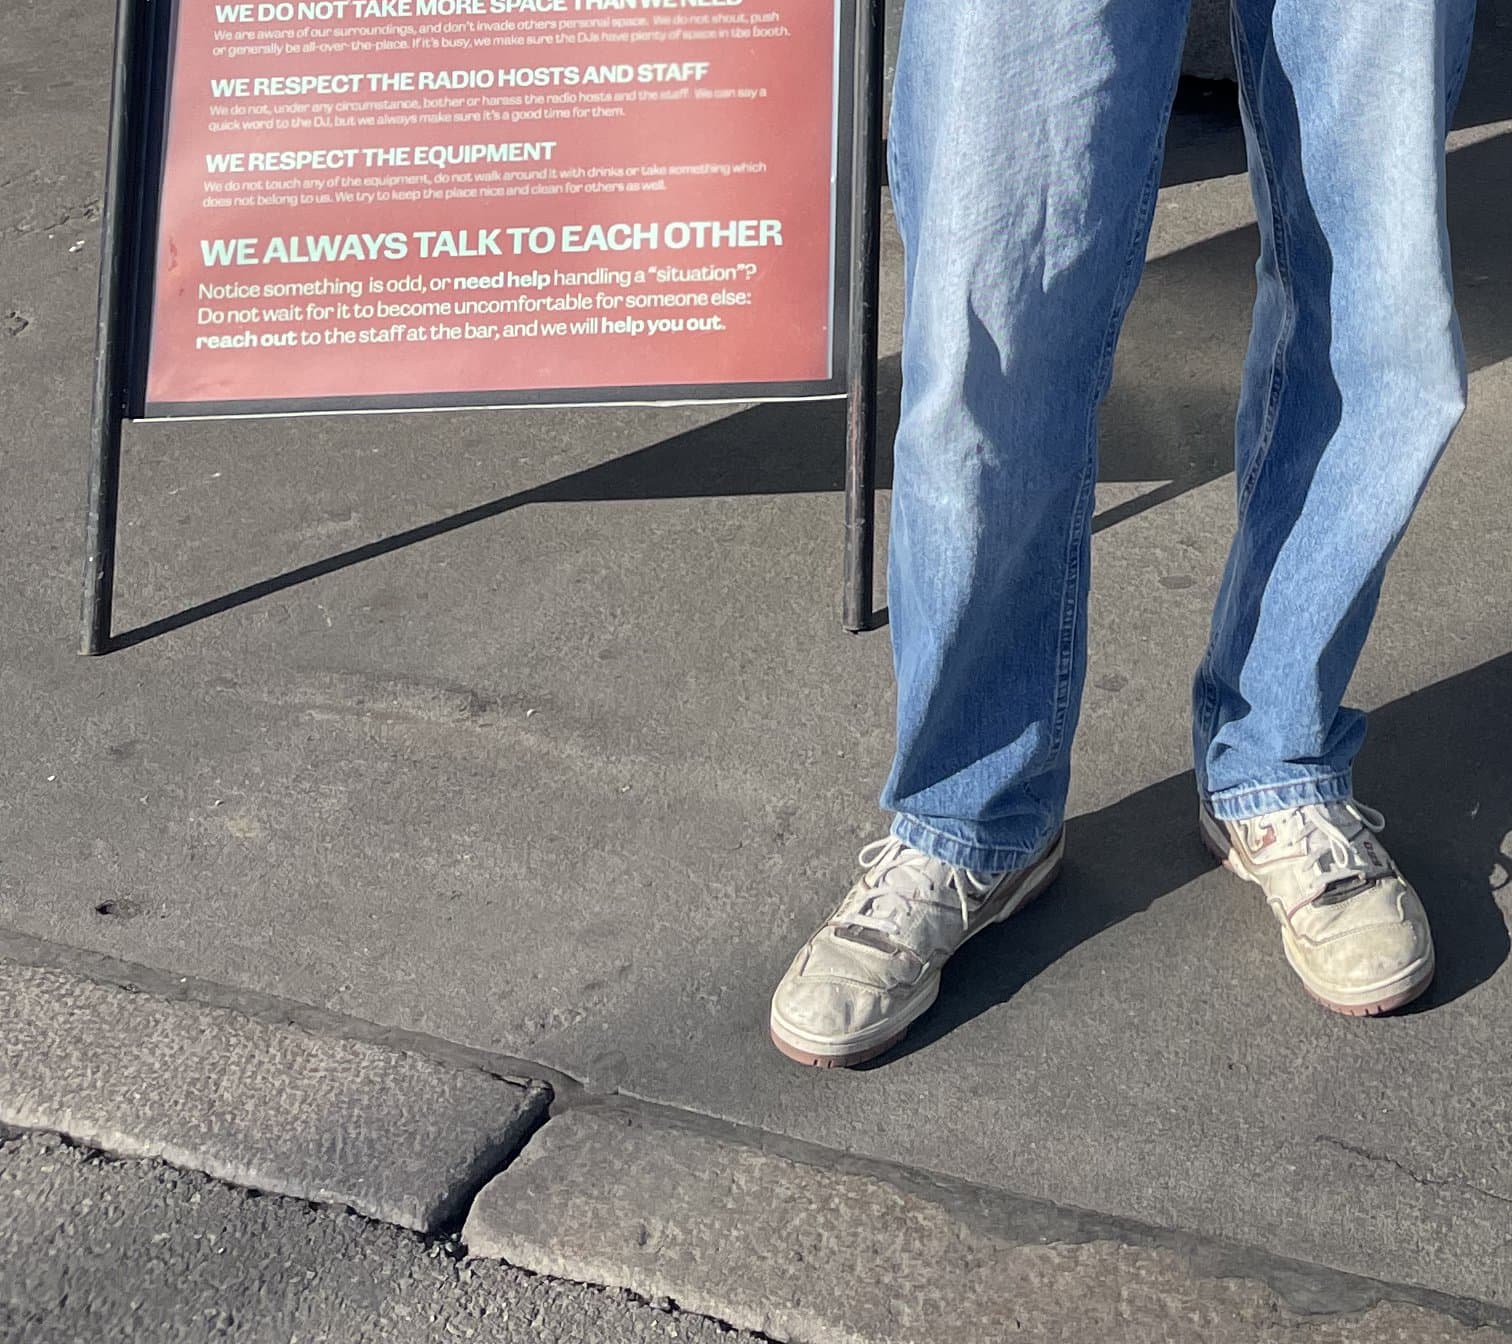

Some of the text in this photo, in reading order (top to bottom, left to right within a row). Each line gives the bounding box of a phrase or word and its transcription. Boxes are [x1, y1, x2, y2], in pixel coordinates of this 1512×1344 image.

[216, 5, 254, 22] WE
[258, 3, 294, 21] DO
[352, 0, 412, 18] TAKE
[211, 62, 709, 97] WE RESPECT THE RADIO HOSTS AND STAFF
[206, 142, 556, 172] WE RESPECT THE EQUIPMENT
[200, 220, 782, 266] WE ALWAYS TALK TO EACH OTHER
[199, 264, 756, 299] Notice something is odd, or need help handling a “situation”?
[198, 289, 751, 324] Do not wait for it to become uncomfortable for someone else:
[196, 315, 726, 349] reach out to the staff at the bar, and we will help you out.
